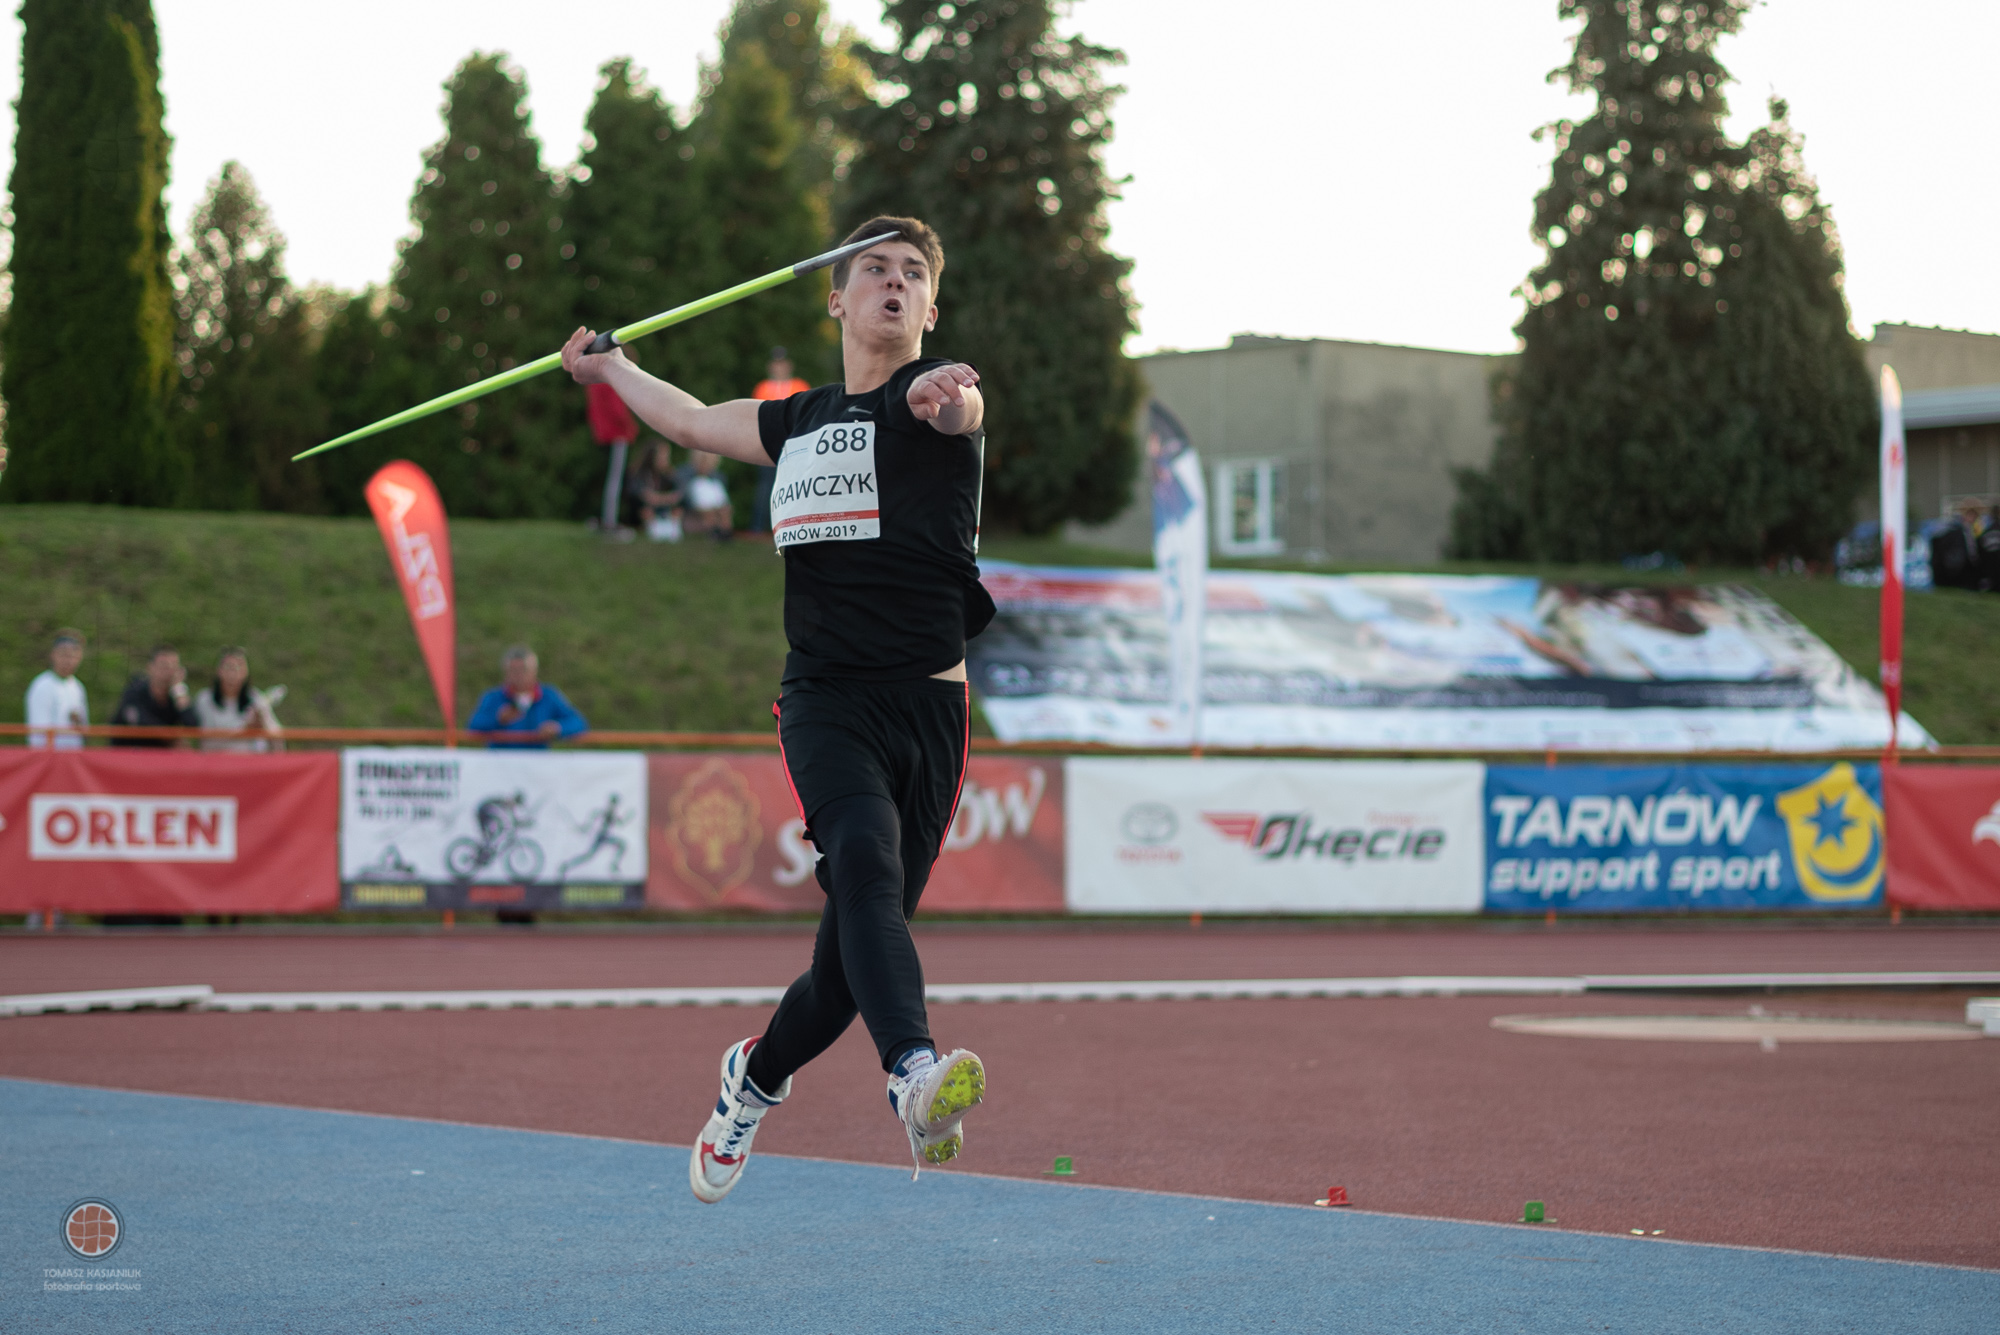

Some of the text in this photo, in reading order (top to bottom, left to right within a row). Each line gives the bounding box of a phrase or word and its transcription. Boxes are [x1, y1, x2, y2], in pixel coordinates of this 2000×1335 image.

[815, 428, 867, 455] 688
[772, 472, 875, 511] KRAWCZYK
[825, 525, 857, 538] 2019
[44, 807, 221, 848] ORLEN
[1491, 788, 1762, 847] TARNÓW
[1489, 850, 1781, 899] support sport
